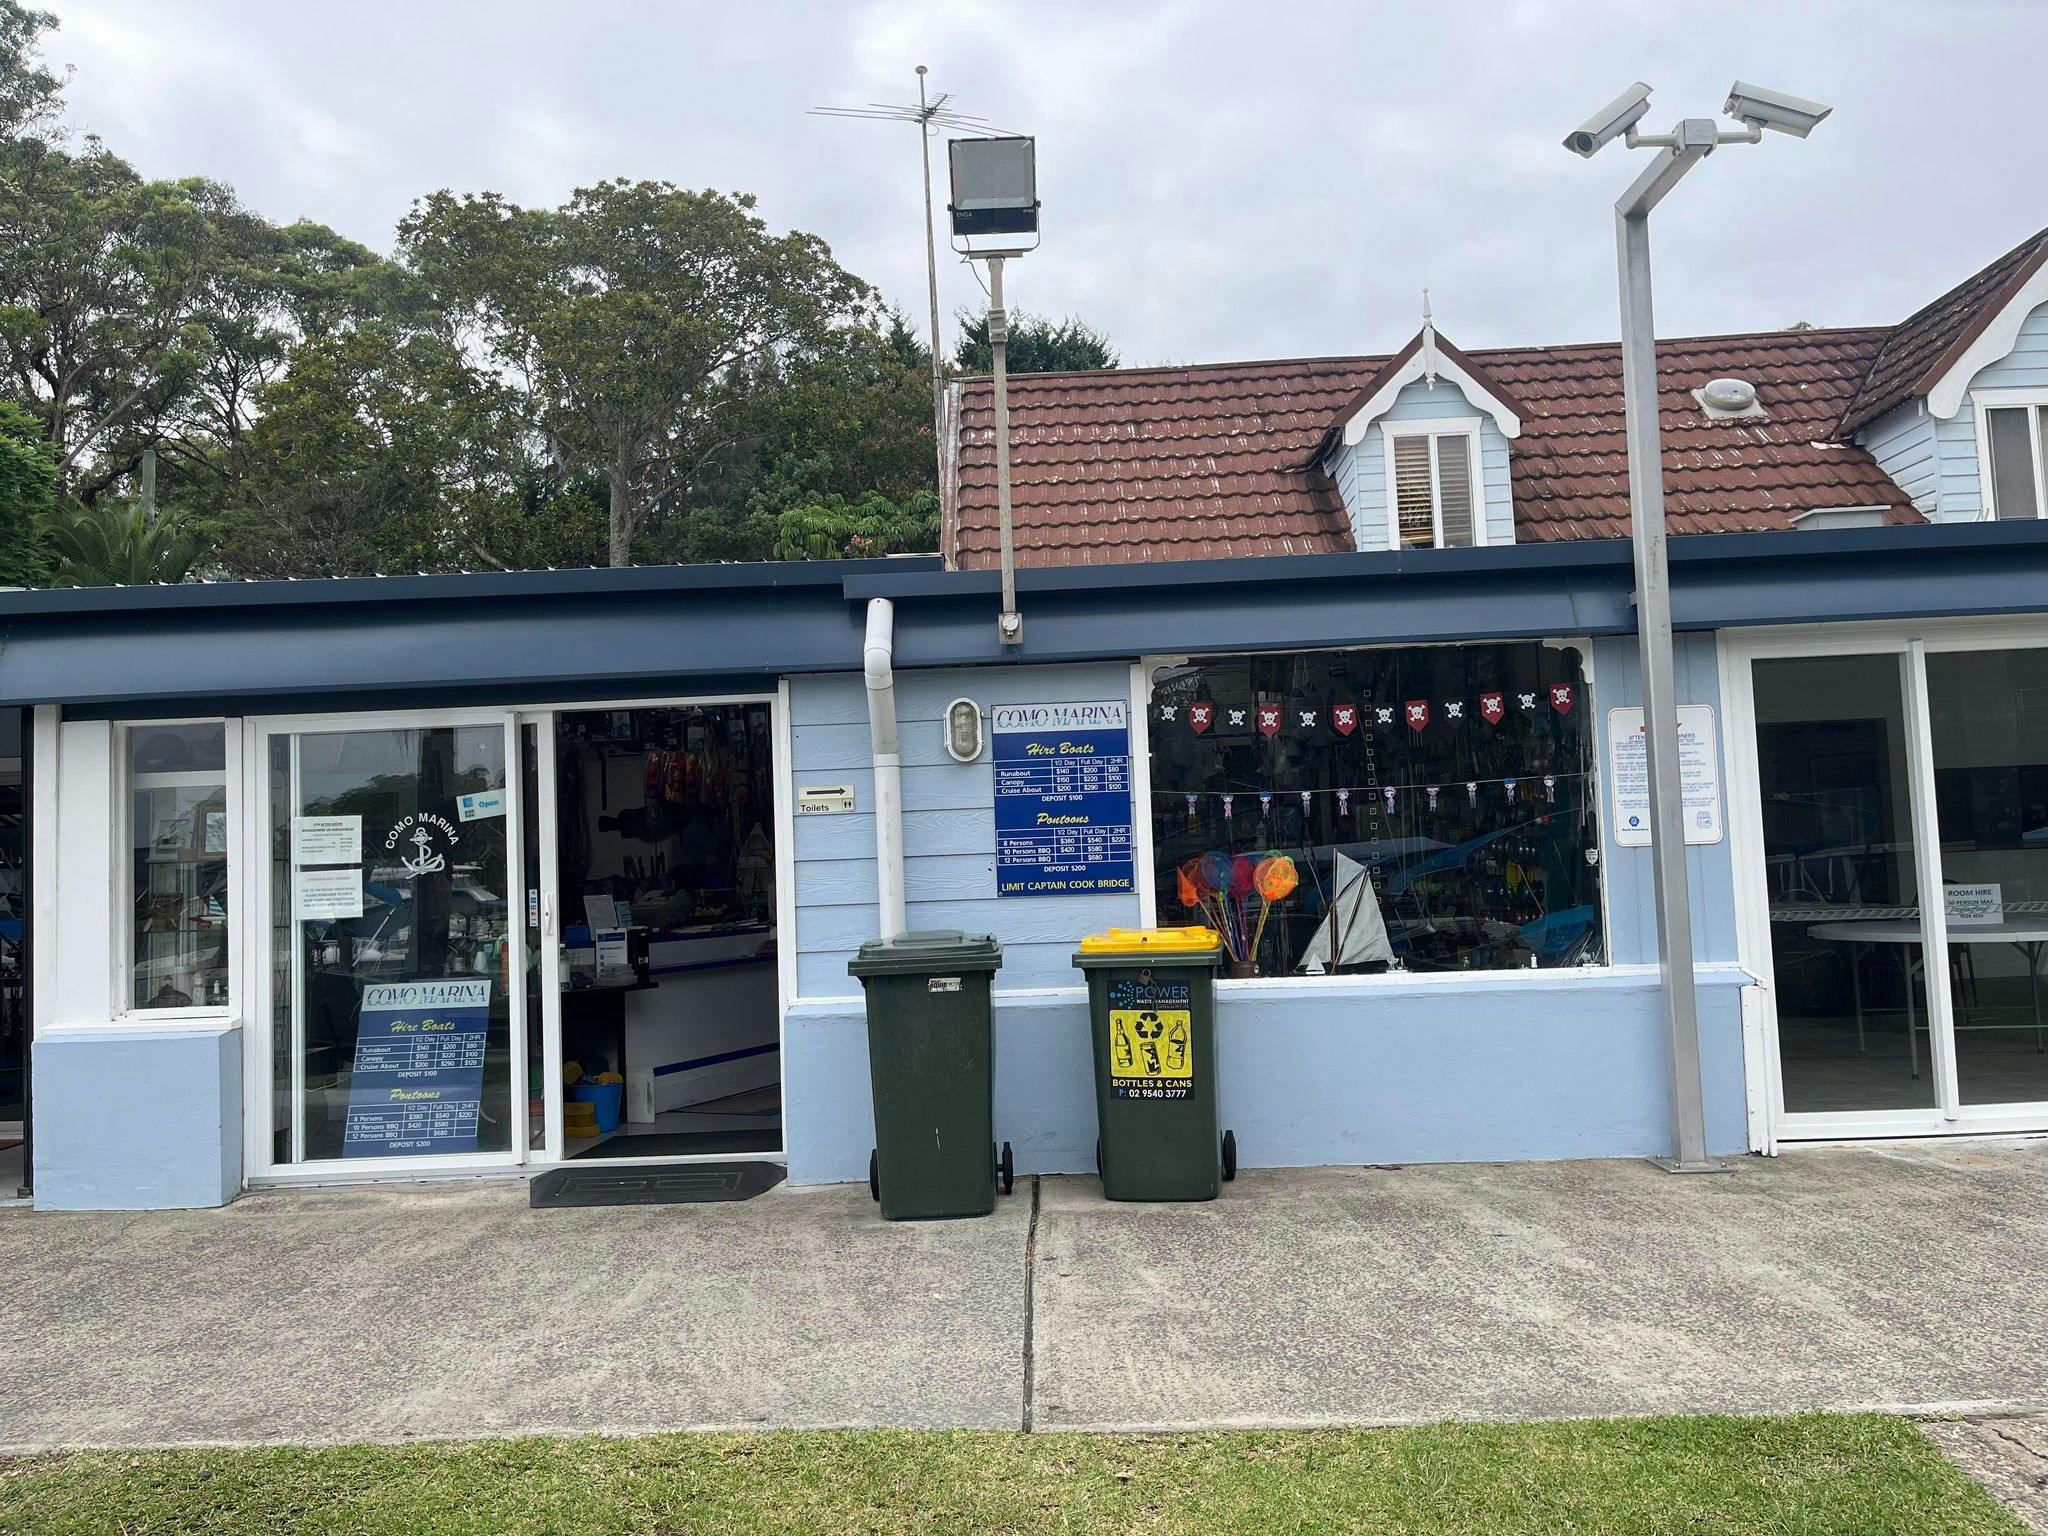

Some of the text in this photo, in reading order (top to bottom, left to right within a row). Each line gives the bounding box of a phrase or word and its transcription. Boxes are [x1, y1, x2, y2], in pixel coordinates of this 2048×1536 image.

[996, 706, 1122, 728] COMO MARINA
[1025, 742, 1095, 756] Hire Boats
[479, 800, 498, 808] Open
[1037, 813, 1090, 826] Pontoons
[385, 812, 459, 849] COMO MARINA
[1002, 879, 1130, 891] LIMIT CAPTAIN COOK BRIDGE
[366, 985, 486, 1006] COMO MARINA
[1136, 986, 1188, 999] POWER
[390, 1019, 455, 1032] Hire Boats
[1112, 1079, 1154, 1087] BOTTLES
[389, 1088, 440, 1100] Pontoons
[1129, 1089, 1140, 1098] 02
[1142, 1089, 1163, 1098] 9540
[1166, 1089, 1187, 1098] 3777
